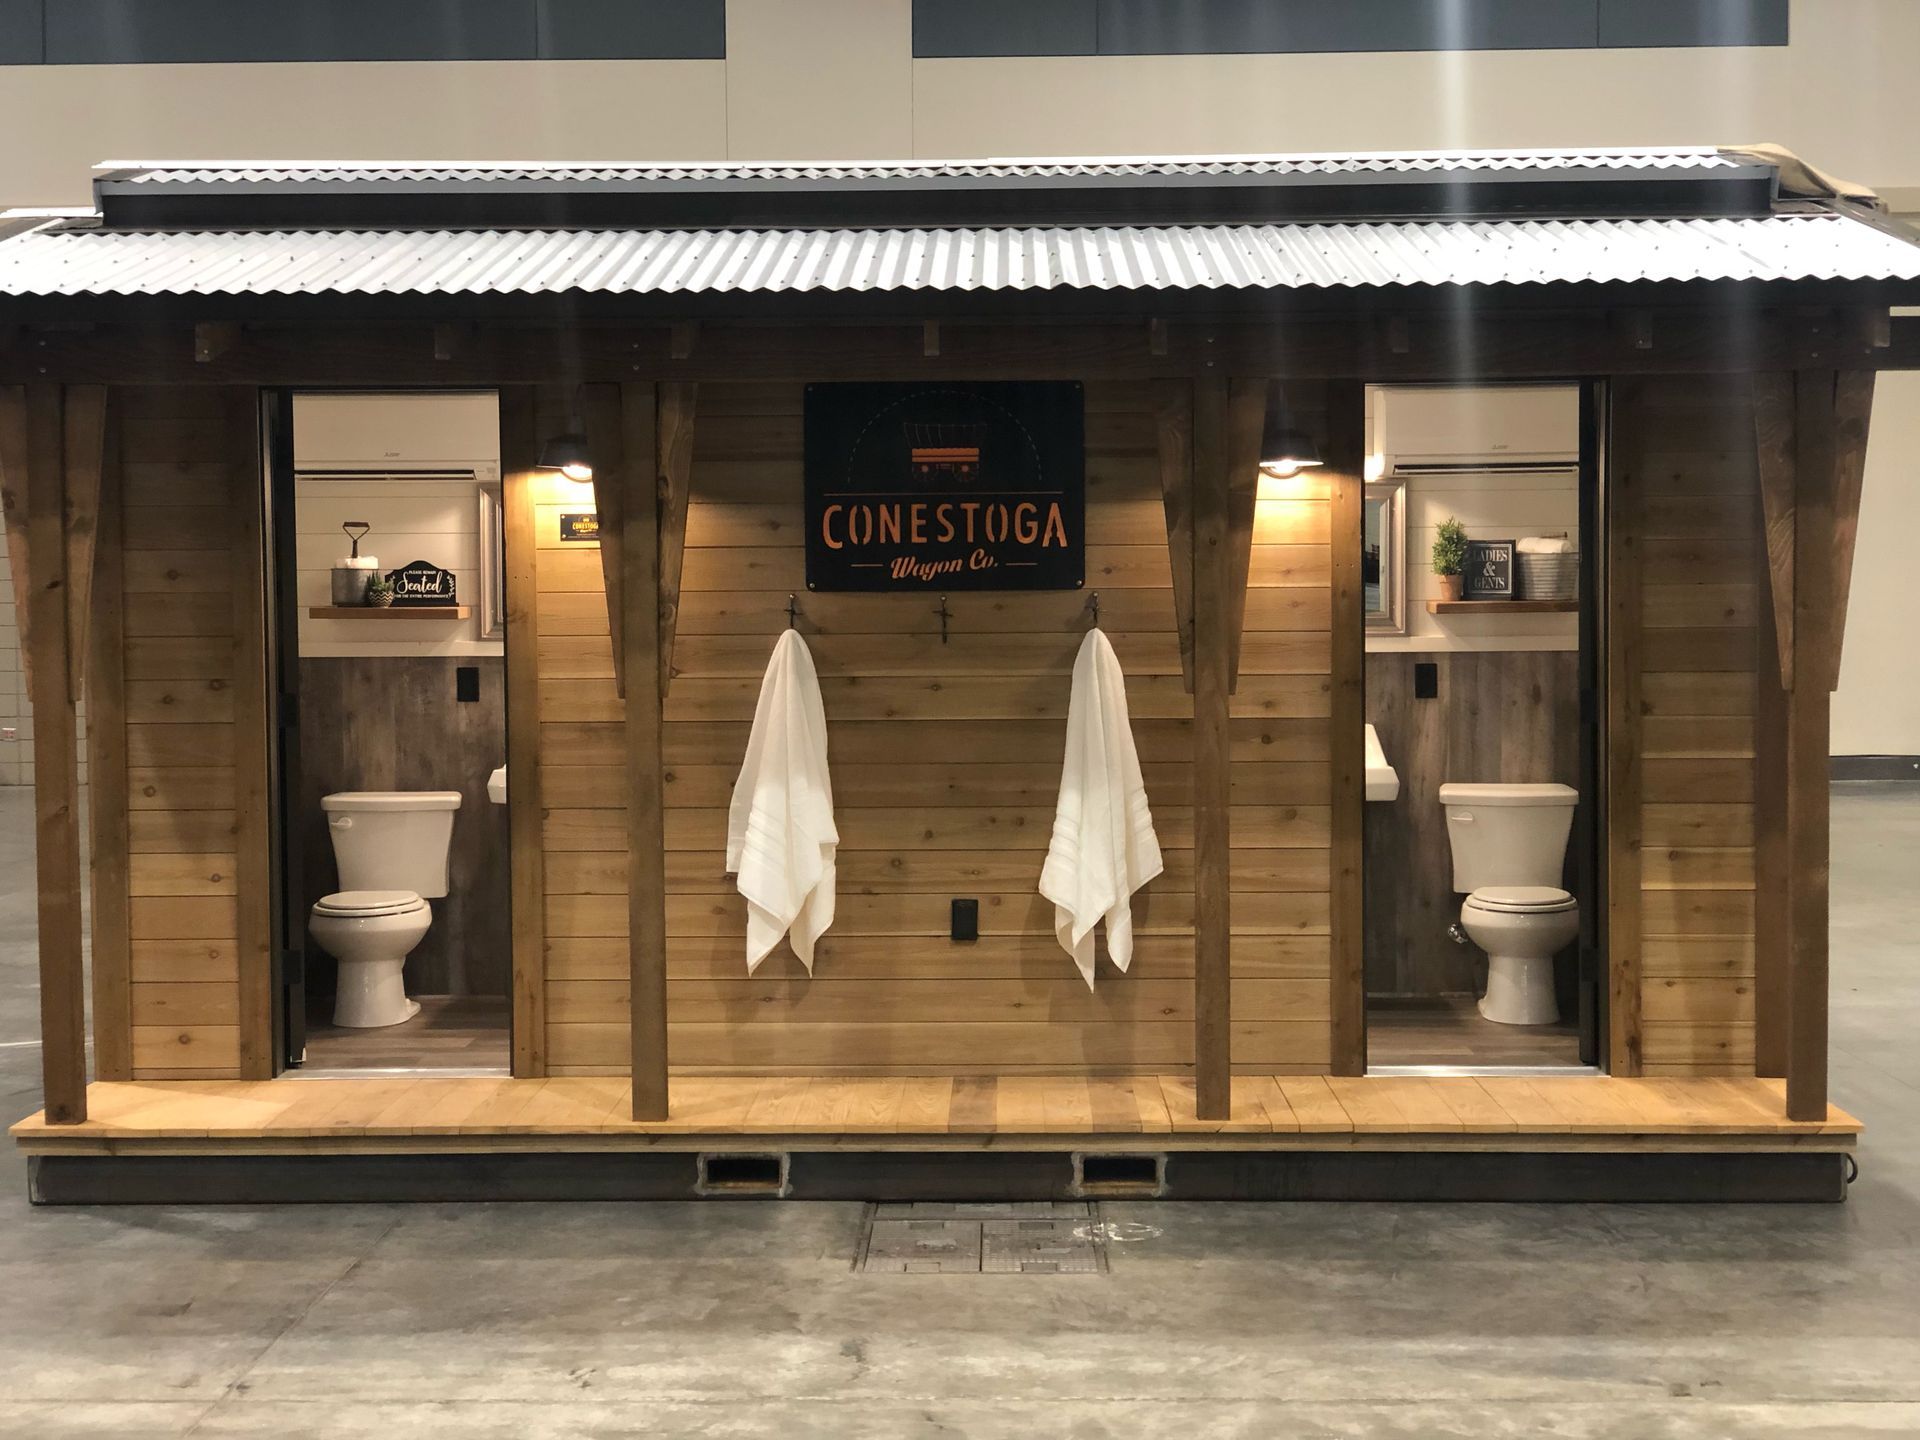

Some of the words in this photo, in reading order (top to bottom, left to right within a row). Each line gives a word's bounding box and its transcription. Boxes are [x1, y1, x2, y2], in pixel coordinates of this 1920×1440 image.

[822, 502, 1068, 549] CONESTOGA
[890, 556, 963, 581] Wagon
[969, 548, 998, 570] Co.
[1482, 561, 1496, 577] &
[396, 570, 443, 594] Seated
[1474, 576, 1506, 589] GENTS
